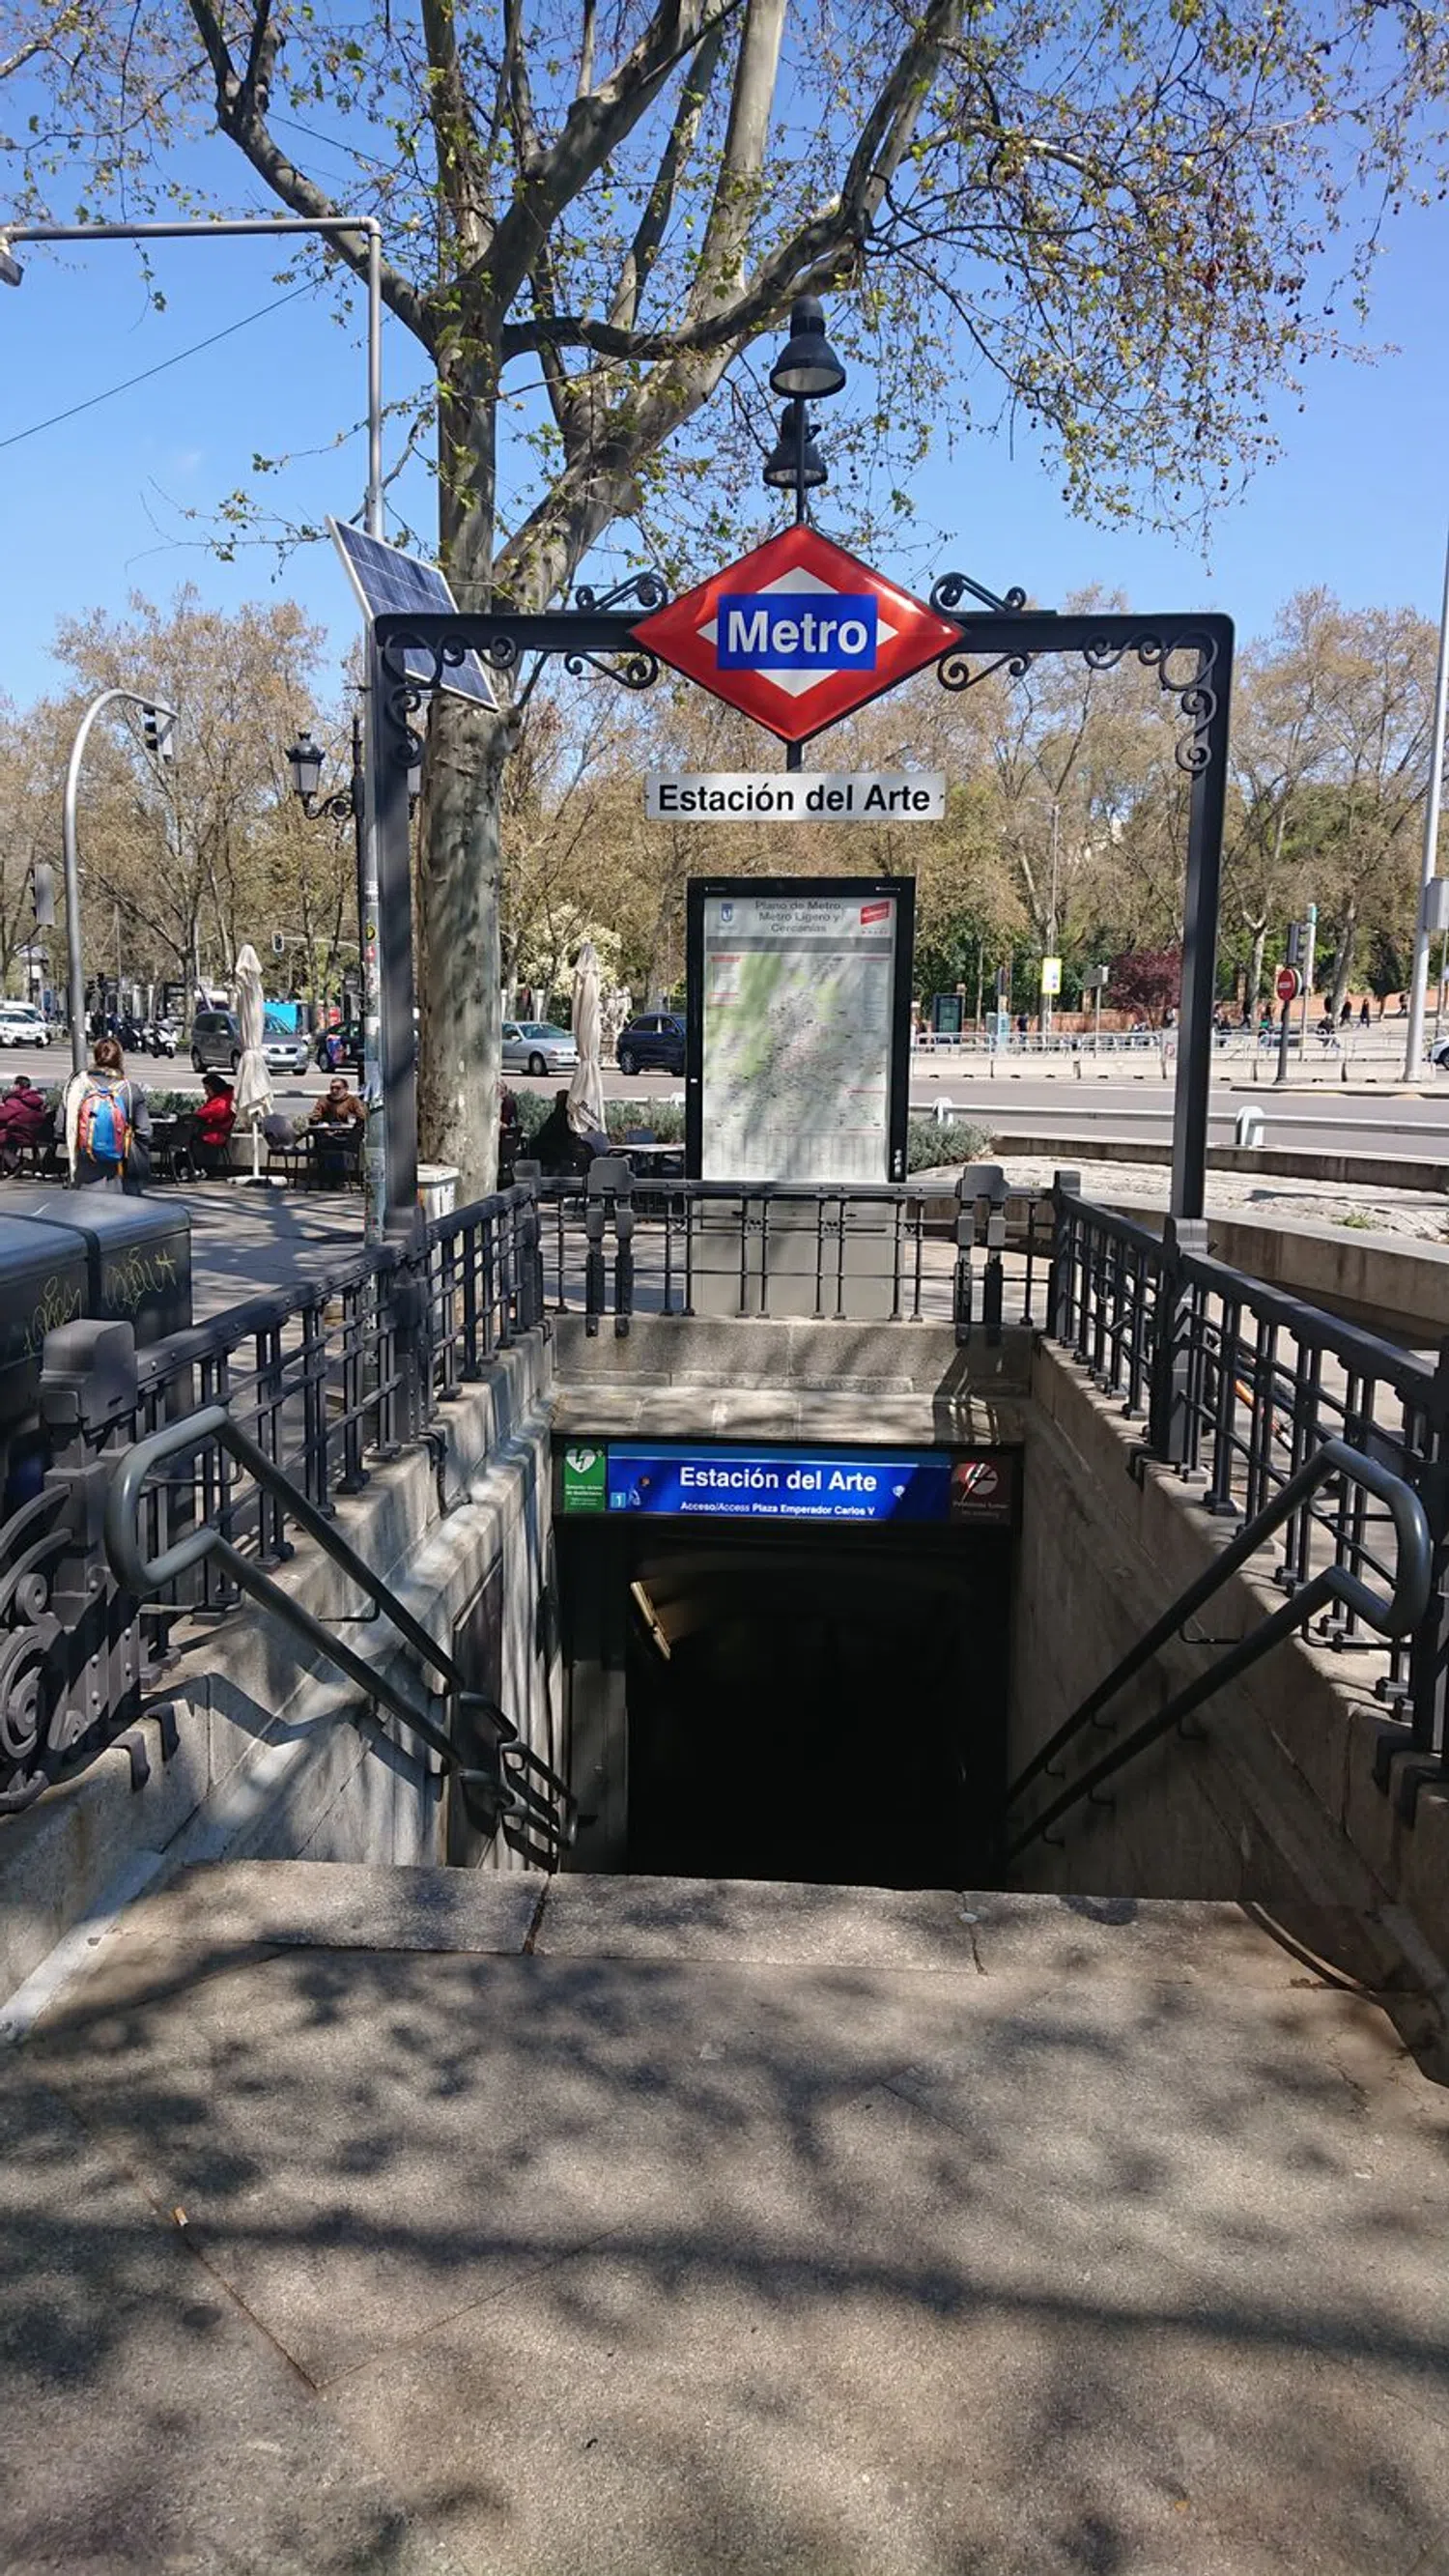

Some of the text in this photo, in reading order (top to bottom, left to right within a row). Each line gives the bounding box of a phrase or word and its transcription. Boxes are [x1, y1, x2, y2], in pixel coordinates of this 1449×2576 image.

[727, 610, 867, 654] Metro
[658, 783, 930, 813] Estación del Arte
[754, 901, 787, 910] Plano
[789, 901, 805, 910] de
[758, 911, 840, 923] Metro Ligero y
[680, 1466, 877, 1492] Estación del Arte
[614, 1494, 623, 1507] 1
[680, 1502, 875, 1516] Acceso/Access Plaza Emperador Carlos V
